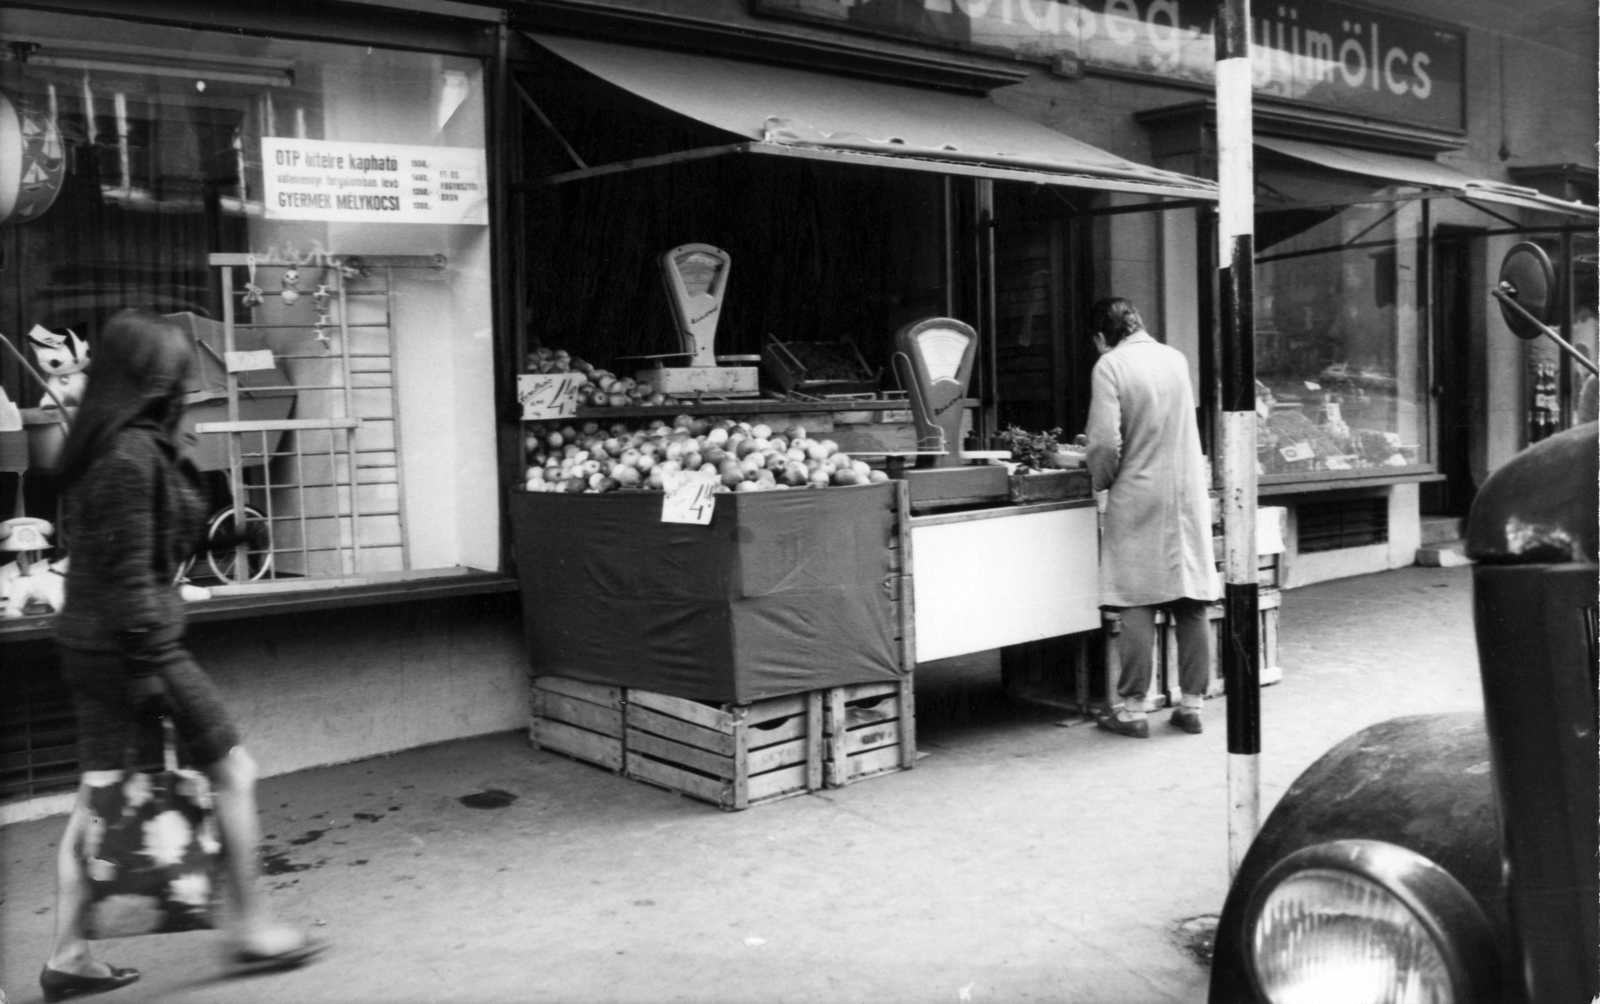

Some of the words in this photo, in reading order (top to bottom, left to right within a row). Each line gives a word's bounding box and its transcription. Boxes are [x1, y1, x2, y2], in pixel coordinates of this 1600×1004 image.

[275, 149, 300, 166] OTP
[305, 150, 344, 170] hitelre
[349, 153, 398, 174] kapható
[276, 172, 323, 187] valamennyi
[327, 175, 377, 189] forgalomban
[278, 191, 332, 209] GYERMEK
[336, 193, 400, 212] MÉLYKOCSI
